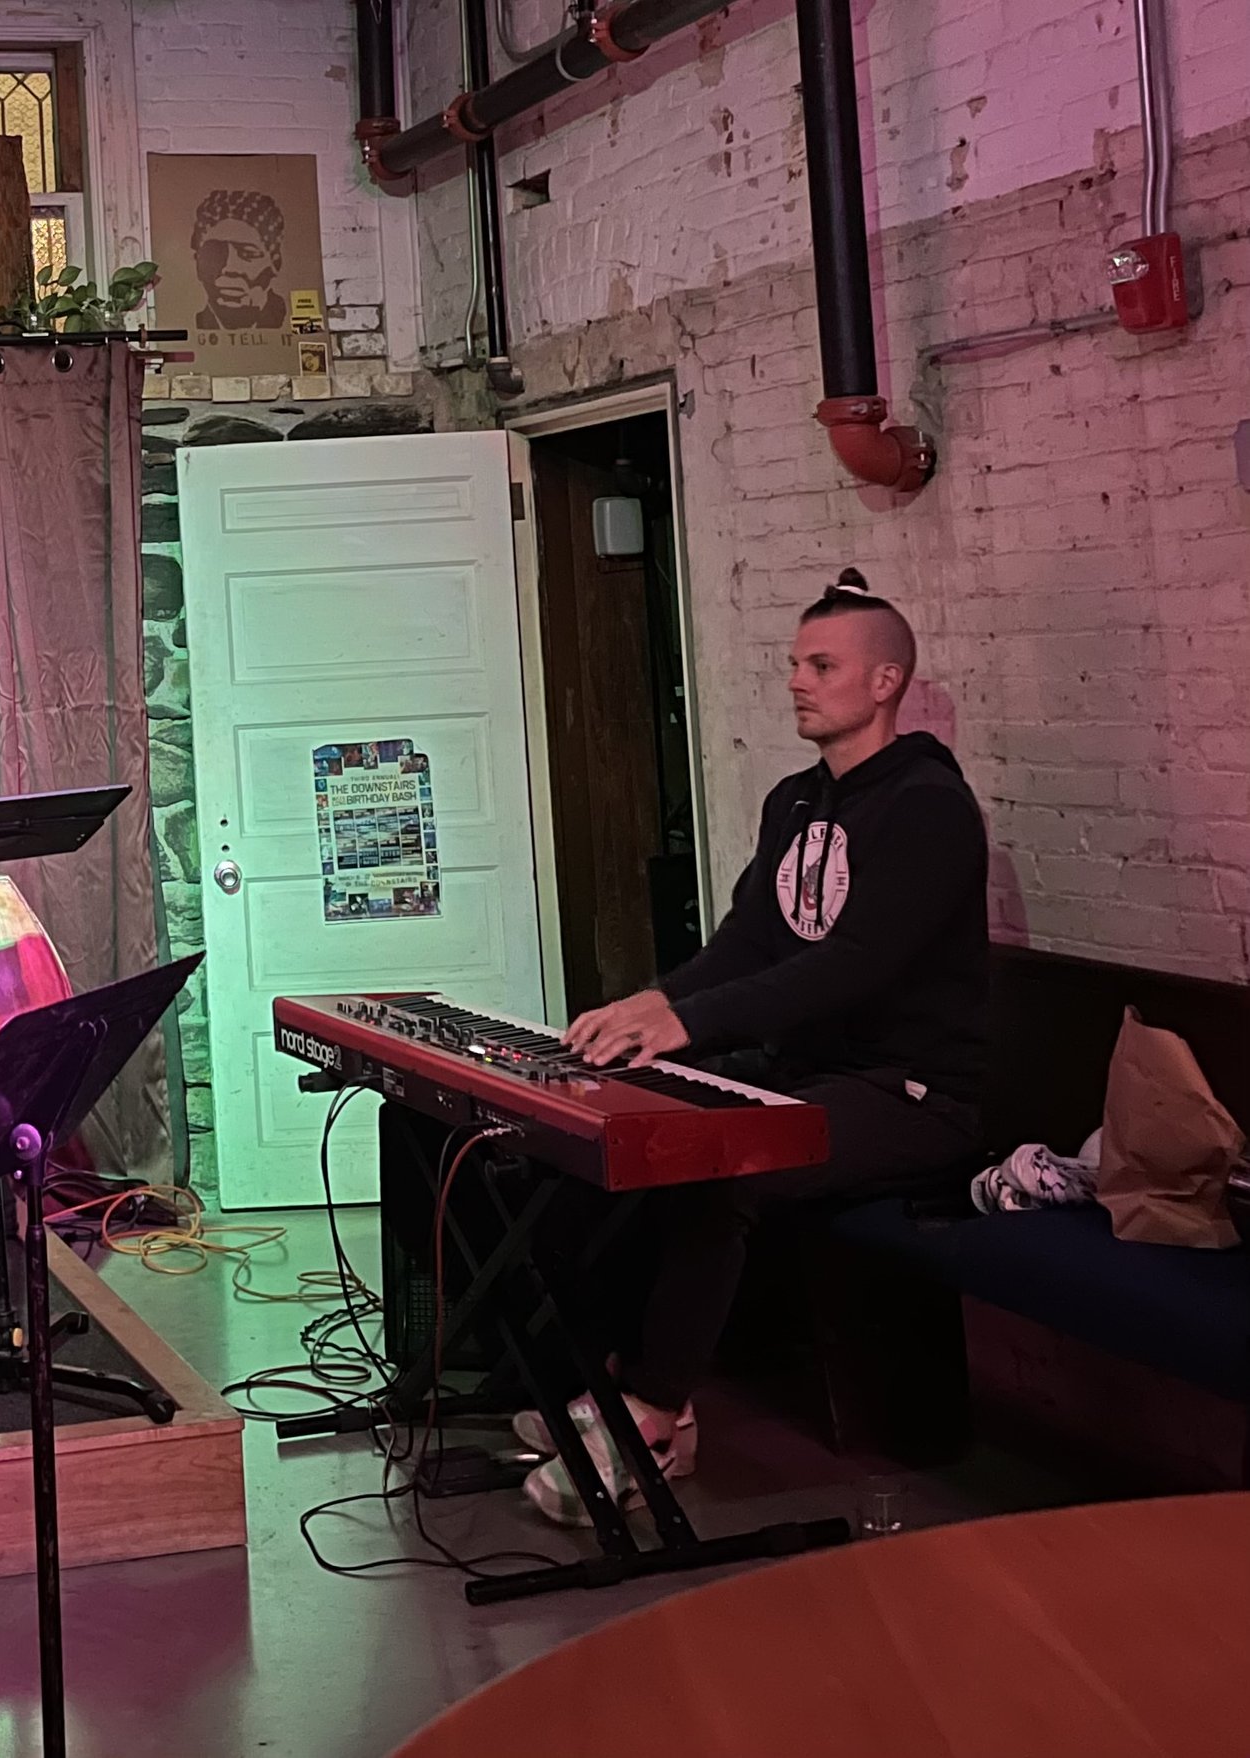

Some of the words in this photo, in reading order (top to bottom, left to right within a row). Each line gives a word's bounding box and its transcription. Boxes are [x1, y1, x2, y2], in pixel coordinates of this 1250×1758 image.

[1170, 255, 1181, 302] FIRE
[198, 332, 218, 346] GO
[228, 332, 268, 346] TELL
[281, 332, 293, 346] IT
[330, 784, 349, 794] THE
[351, 780, 416, 793] DOWNSTAIRS
[346, 793, 390, 805] BIRTHDAY
[392, 791, 417, 802] BASH
[280, 1028, 305, 1053] nord
